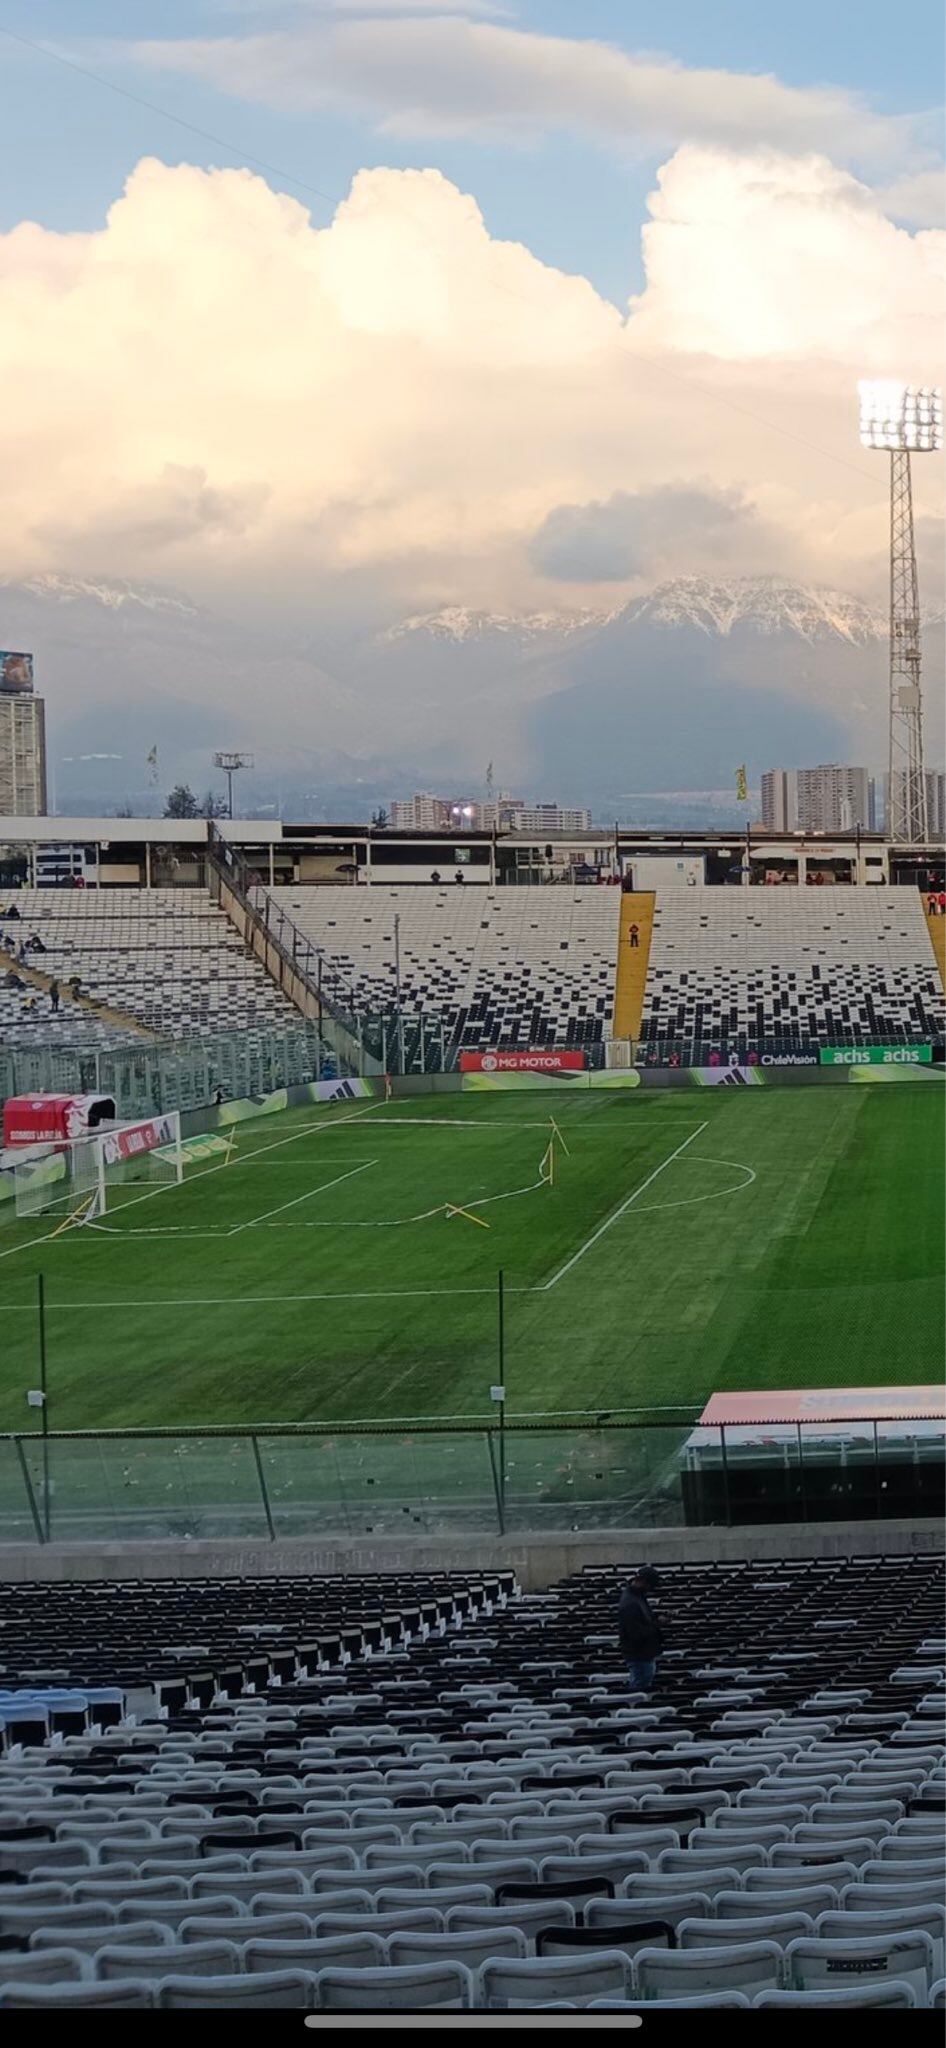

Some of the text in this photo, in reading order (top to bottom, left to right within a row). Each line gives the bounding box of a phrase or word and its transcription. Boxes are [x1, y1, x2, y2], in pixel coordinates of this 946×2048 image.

[499, 1058, 518, 1067] MG
[520, 1057, 561, 1067] MOTOR
[834, 1049, 870, 1063] achs
[883, 1048, 920, 1062] achs
